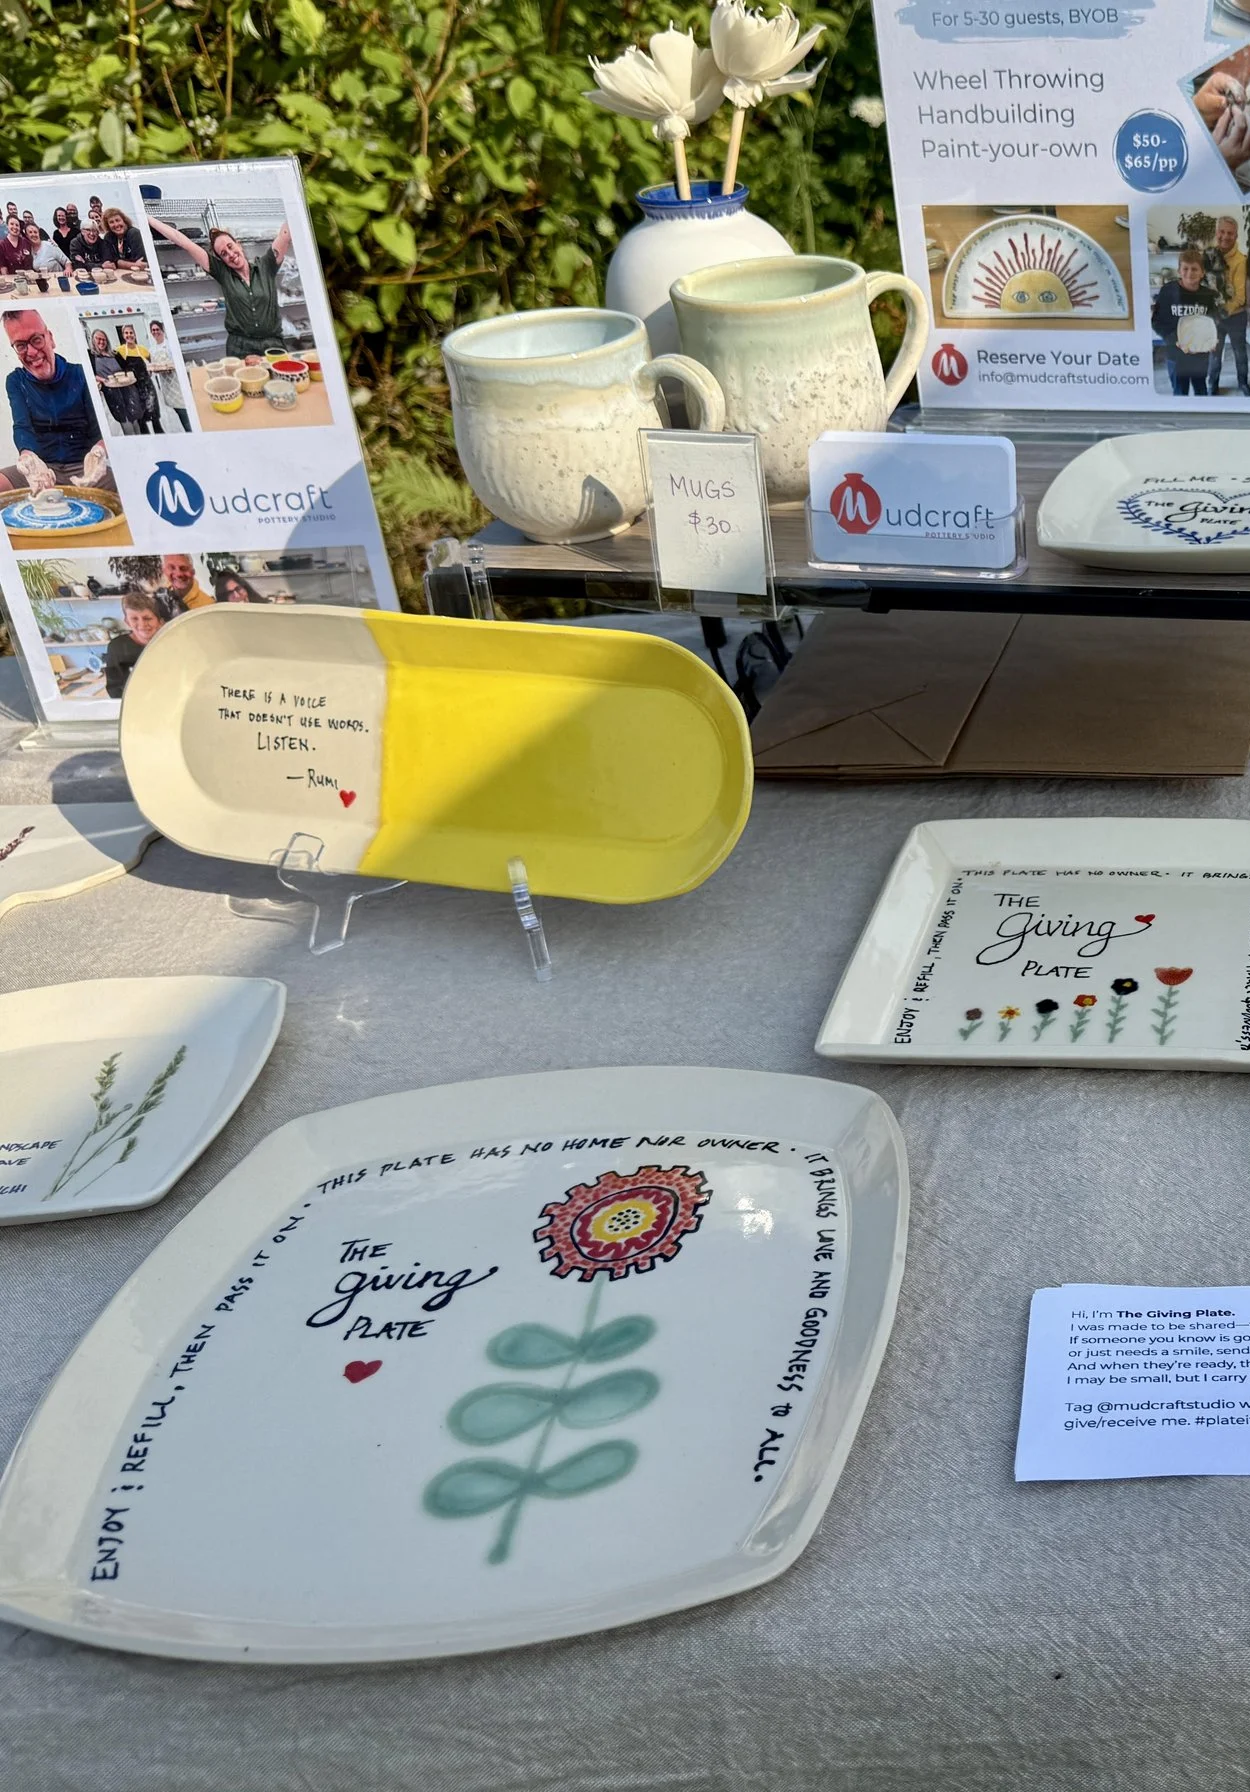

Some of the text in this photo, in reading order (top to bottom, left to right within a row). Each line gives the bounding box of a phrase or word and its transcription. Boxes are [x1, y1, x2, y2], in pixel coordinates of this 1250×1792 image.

[932, 8, 1118, 29] For 5-30 guests, BYOB
[913, 68, 1103, 92] Wheel Throwing
[918, 103, 1074, 127] Handbuilding
[922, 138, 1097, 162] Paint-your-own
[1132, 134, 1166, 149] $50-
[1125, 155, 1177, 172] $65/pp
[977, 350, 1140, 366] Reserve Your Date
[979, 370, 1149, 385] info@mudcraftstudio.com
[155, 473, 332, 519] Mudcraft
[670, 473, 735, 500] MUGS
[258, 514, 336, 524] POTTERY STUDIO
[688, 509, 731, 535] $30
[221, 686, 326, 709] THERE IS A VOICE
[218, 708, 368, 732] THAT DOESN'T USE WORDS.
[258, 732, 315, 751] LISTEN.
[994, 894, 1040, 907] THE
[1021, 960, 1093, 978] PLATE
[317, 1168, 367, 1194] THIS
[380, 1154, 456, 1176] PLATE
[470, 1145, 511, 1159] HAS
[520, 1142, 553, 1155] NO
[562, 1137, 631, 1151] HOME
[636, 1135, 685, 1147] NOR
[340, 1239, 392, 1263] THE
[1072, 1310, 1088, 1319] Hi,
[1093, 1310, 1112, 1318] I'm
[1147, 1310, 1191, 1319] Giving
[1196, 1309, 1235, 1317] Plate.
[343, 1316, 435, 1341] PLATE
[1065, 1403, 1092, 1414] Tag
[1097, 1399, 1235, 1413] @mudcraftstudio
[1064, 1416, 1157, 1431] give/receive
